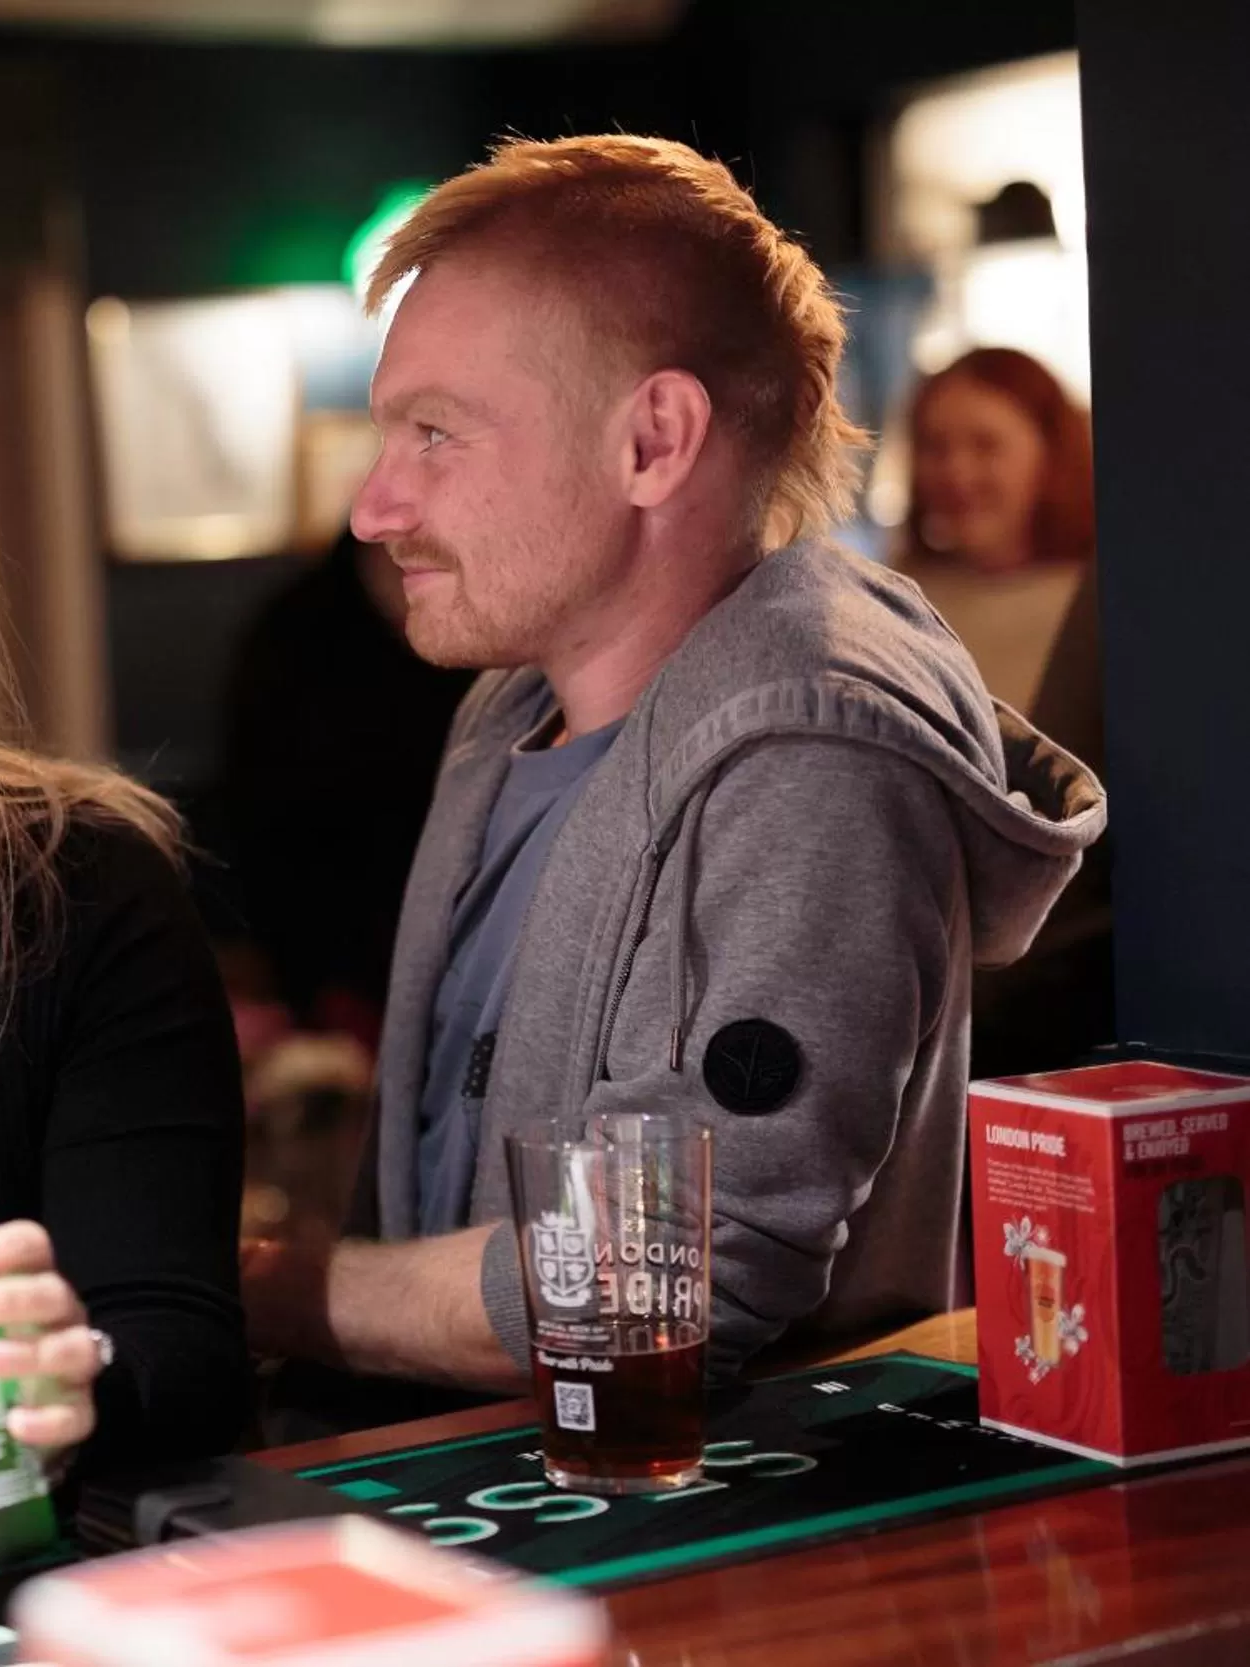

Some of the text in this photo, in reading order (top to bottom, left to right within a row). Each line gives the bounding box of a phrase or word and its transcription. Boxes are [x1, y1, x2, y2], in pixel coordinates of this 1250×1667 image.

[1181, 1112, 1229, 1135] SERVED
[985, 1124, 1067, 1158] LONDON PRIDE
